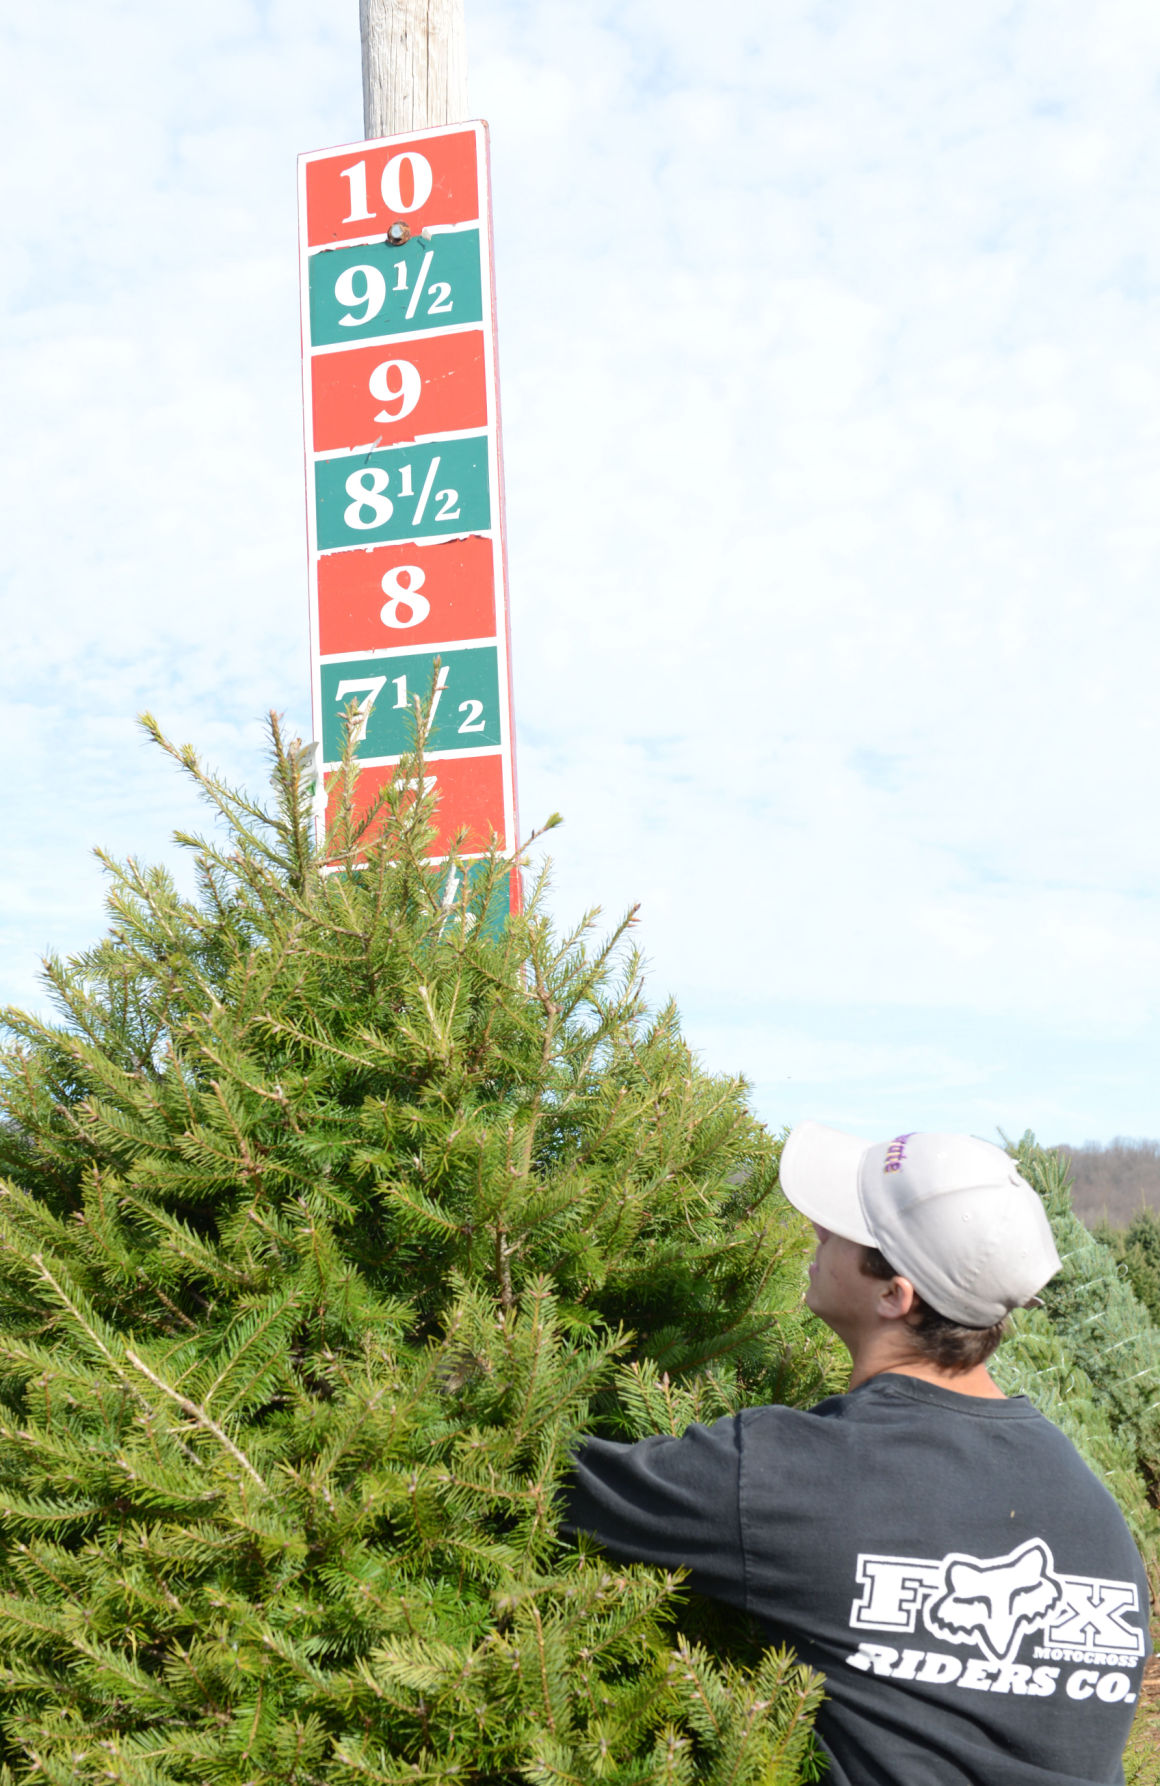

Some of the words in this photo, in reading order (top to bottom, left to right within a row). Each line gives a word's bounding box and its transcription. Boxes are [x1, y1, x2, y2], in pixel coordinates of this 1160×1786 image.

[339, 151, 433, 224] 10
[368, 359, 422, 423] 9
[379, 565, 431, 629] 8
[846, 1642, 1060, 1697] RIDERS
[1065, 1669, 1137, 1703] CO.
[1033, 1646, 1139, 1668] MOTOCROSS
